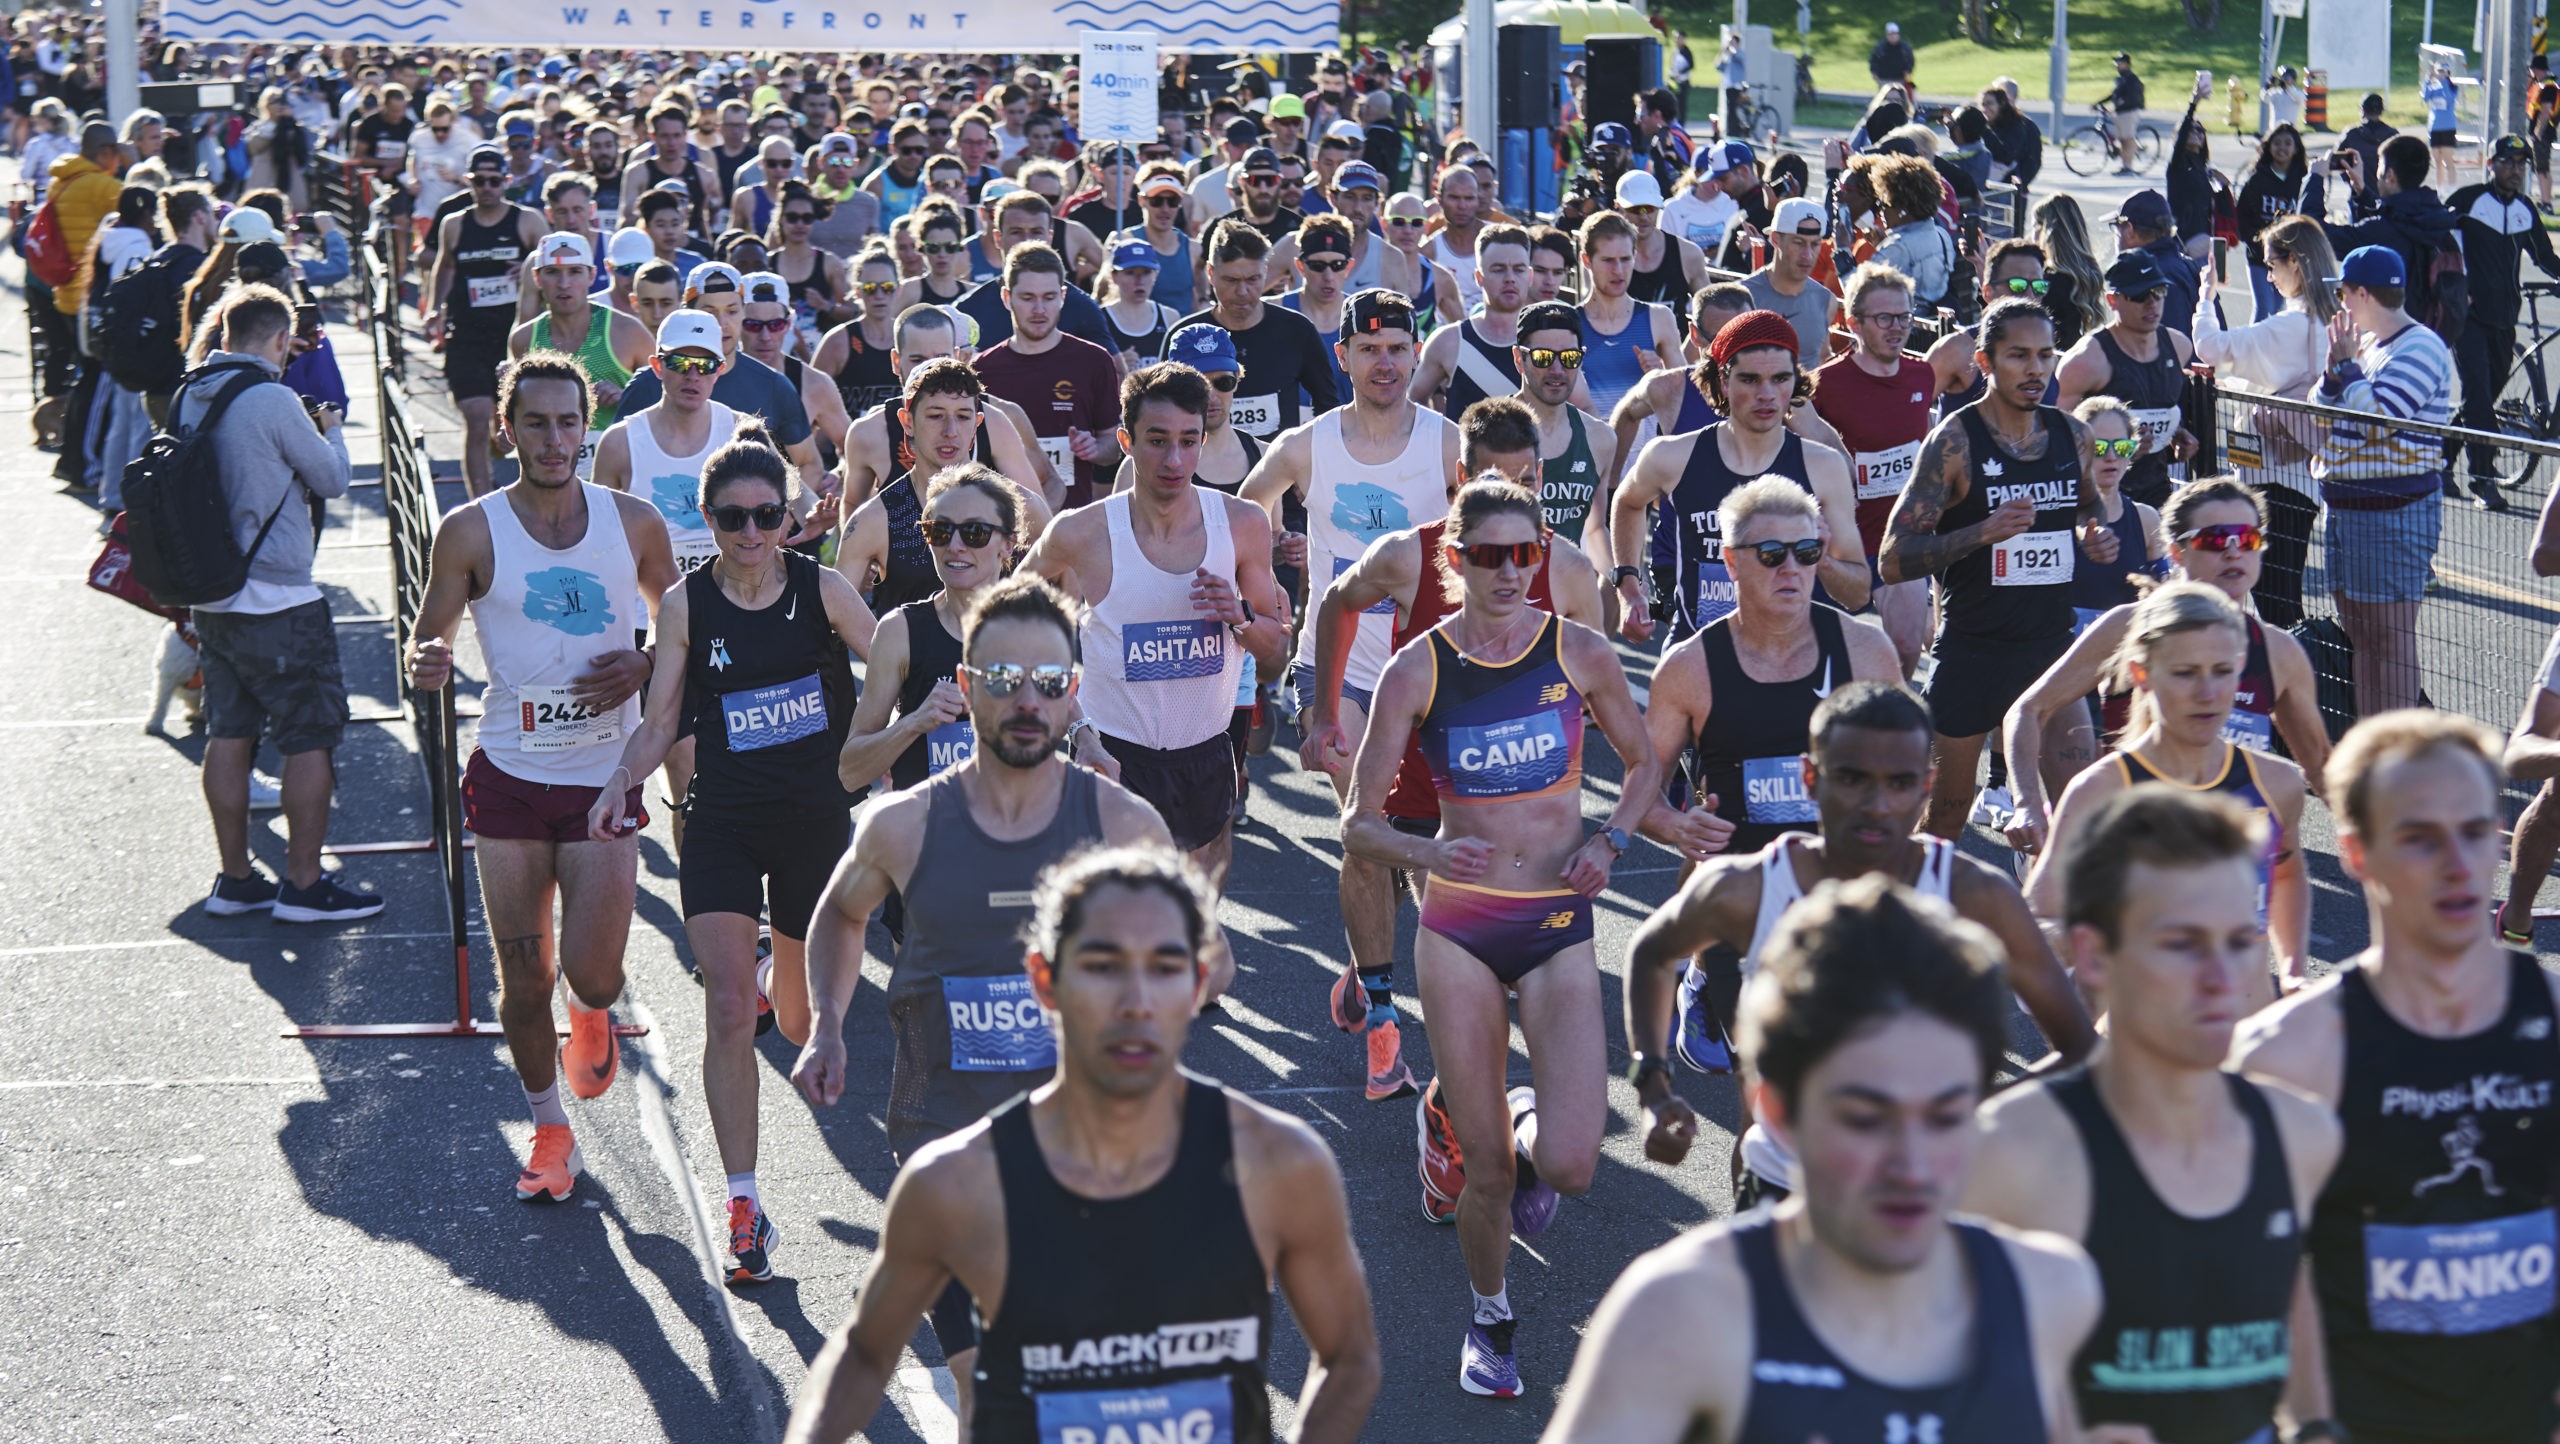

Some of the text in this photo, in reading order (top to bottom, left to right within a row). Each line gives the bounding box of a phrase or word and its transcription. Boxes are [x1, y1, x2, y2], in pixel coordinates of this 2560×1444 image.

[562, 7, 968, 29] WATERFRONT
[1091, 73, 1149, 88] 40min
[1229, 408, 1267, 425] 283
[1870, 456, 1913, 479] 2765
[1538, 482, 1593, 502] ONTO
[1986, 480, 2078, 508] PARKDALE
[2014, 548, 2060, 569] 1921
[1127, 634, 1221, 664] ASHTARI
[728, 691, 822, 733] DEVINE
[555, 722, 588, 731] UMBERTO
[597, 732, 612, 741] 2423
[1460, 733, 1556, 771] CAMP
[2371, 1244, 2554, 1301] KANKO
